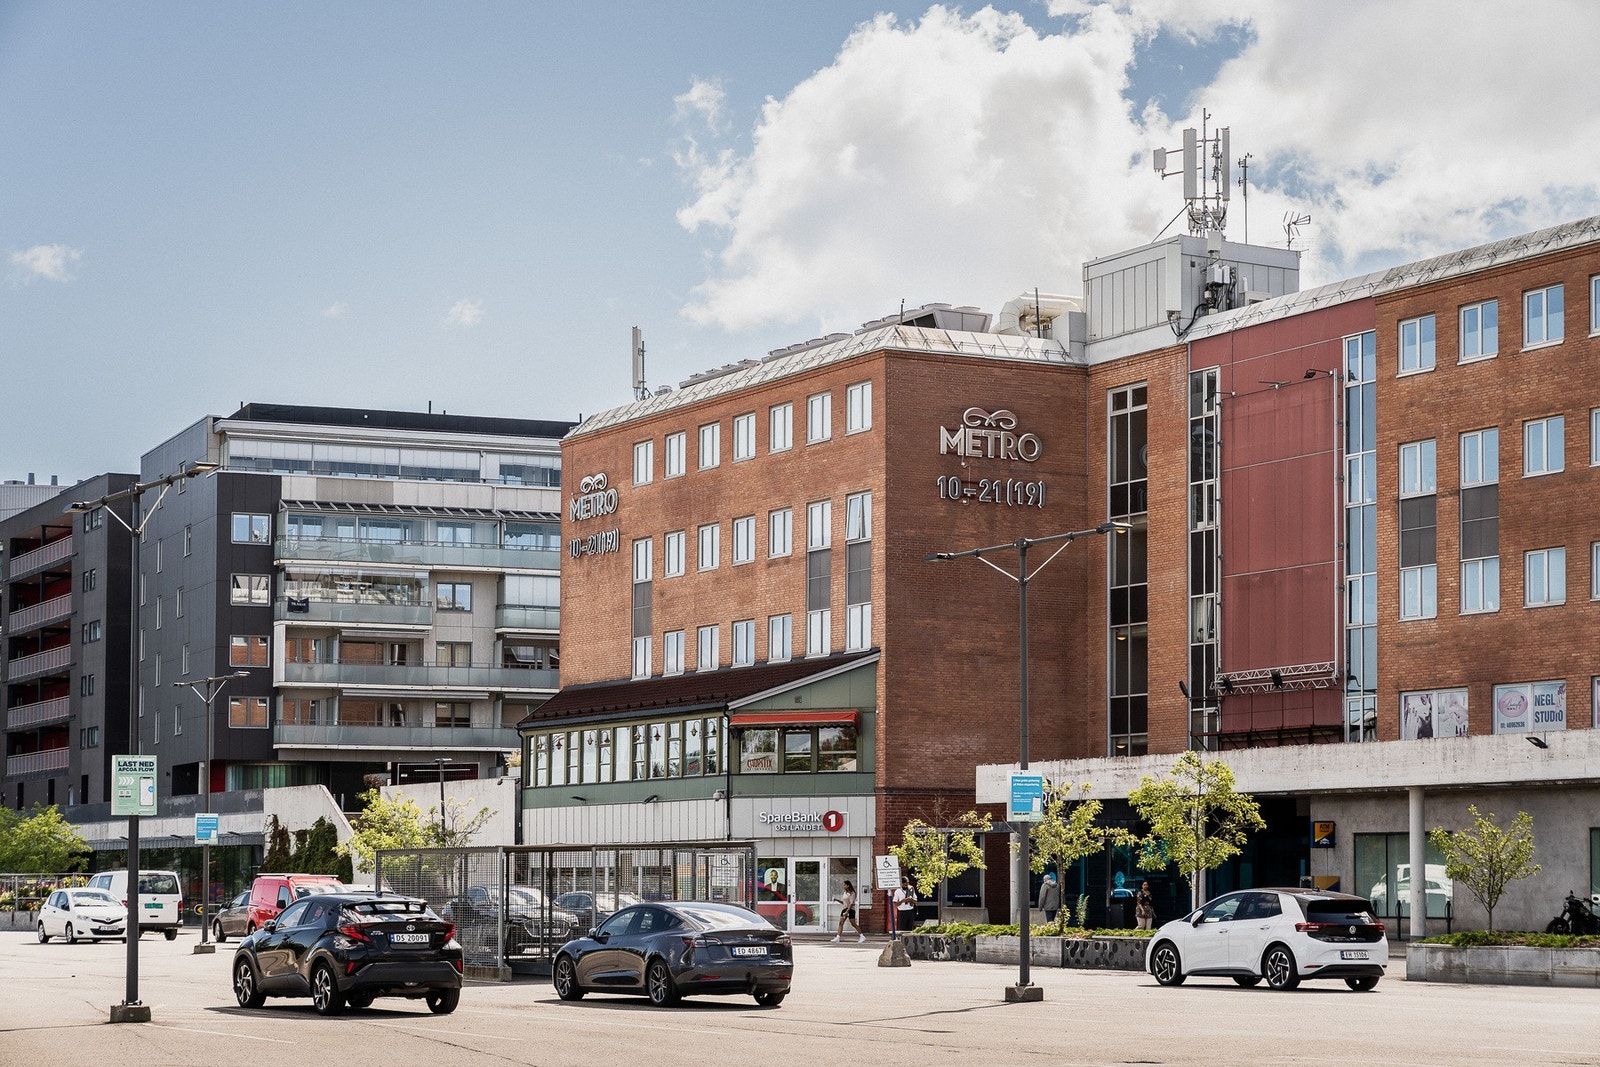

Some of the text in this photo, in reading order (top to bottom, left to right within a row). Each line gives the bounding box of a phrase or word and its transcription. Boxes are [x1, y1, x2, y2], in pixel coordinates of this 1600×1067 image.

[940, 425, 1042, 461] METRO
[569, 488, 618, 522] METRO
[1534, 693, 1555, 707] NEGL
[1534, 710, 1564, 723] STUDIO
[759, 811, 821, 824] SpareBank
[775, 824, 822, 832] ØSTLANDET
[395, 934, 428, 942] DS 20091
[747, 946, 766, 954] 48671
